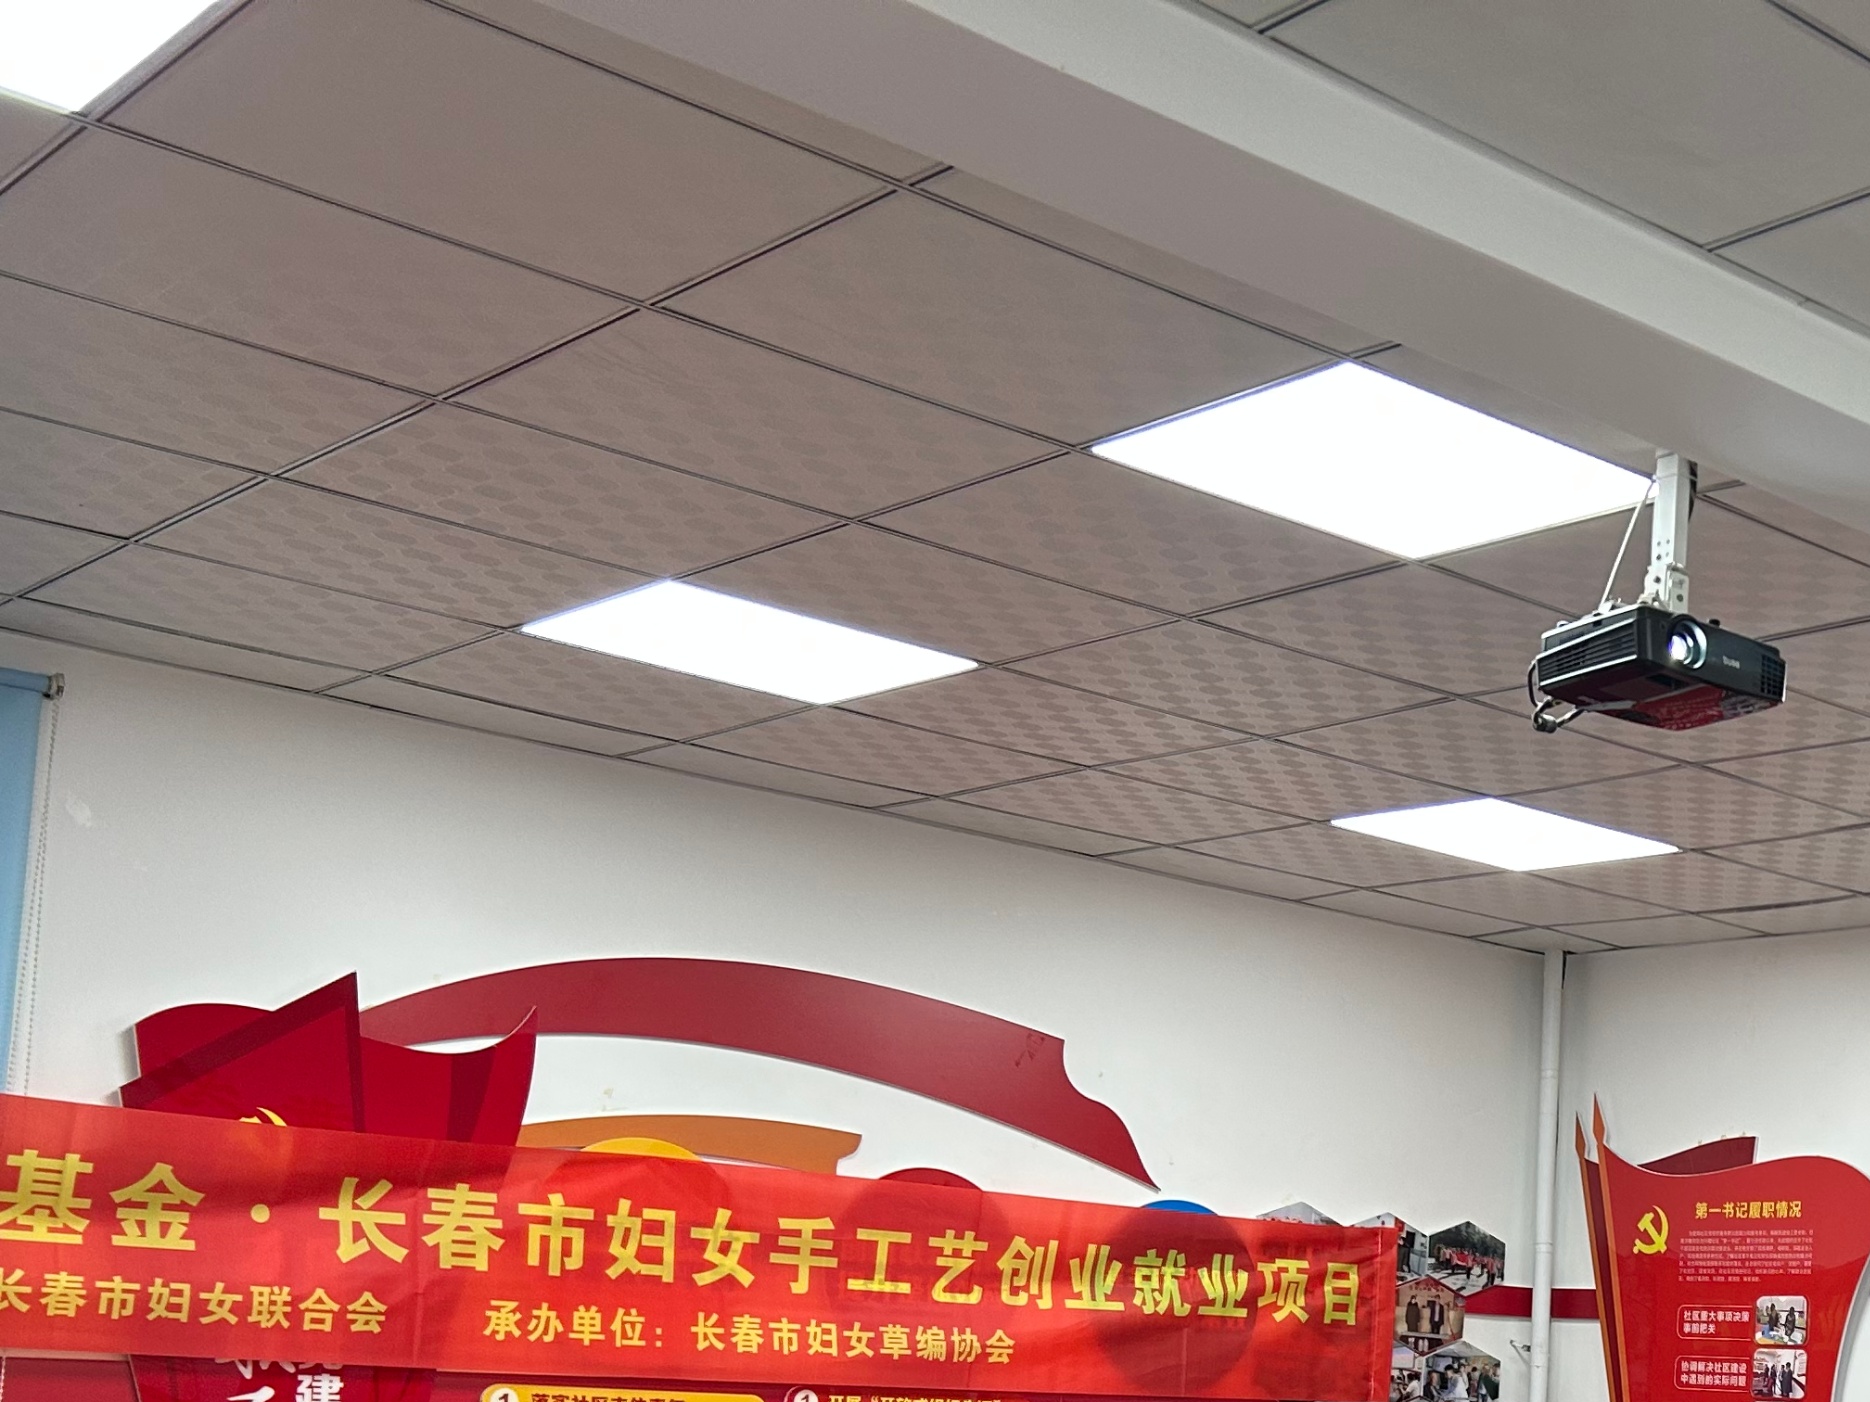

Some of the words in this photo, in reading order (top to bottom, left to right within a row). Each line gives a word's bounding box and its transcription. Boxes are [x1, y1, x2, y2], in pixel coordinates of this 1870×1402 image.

[1695, 1200, 1802, 1219] 第一书记履职情况
[0, 1266, 389, 1334] 长春市妇女联合会
